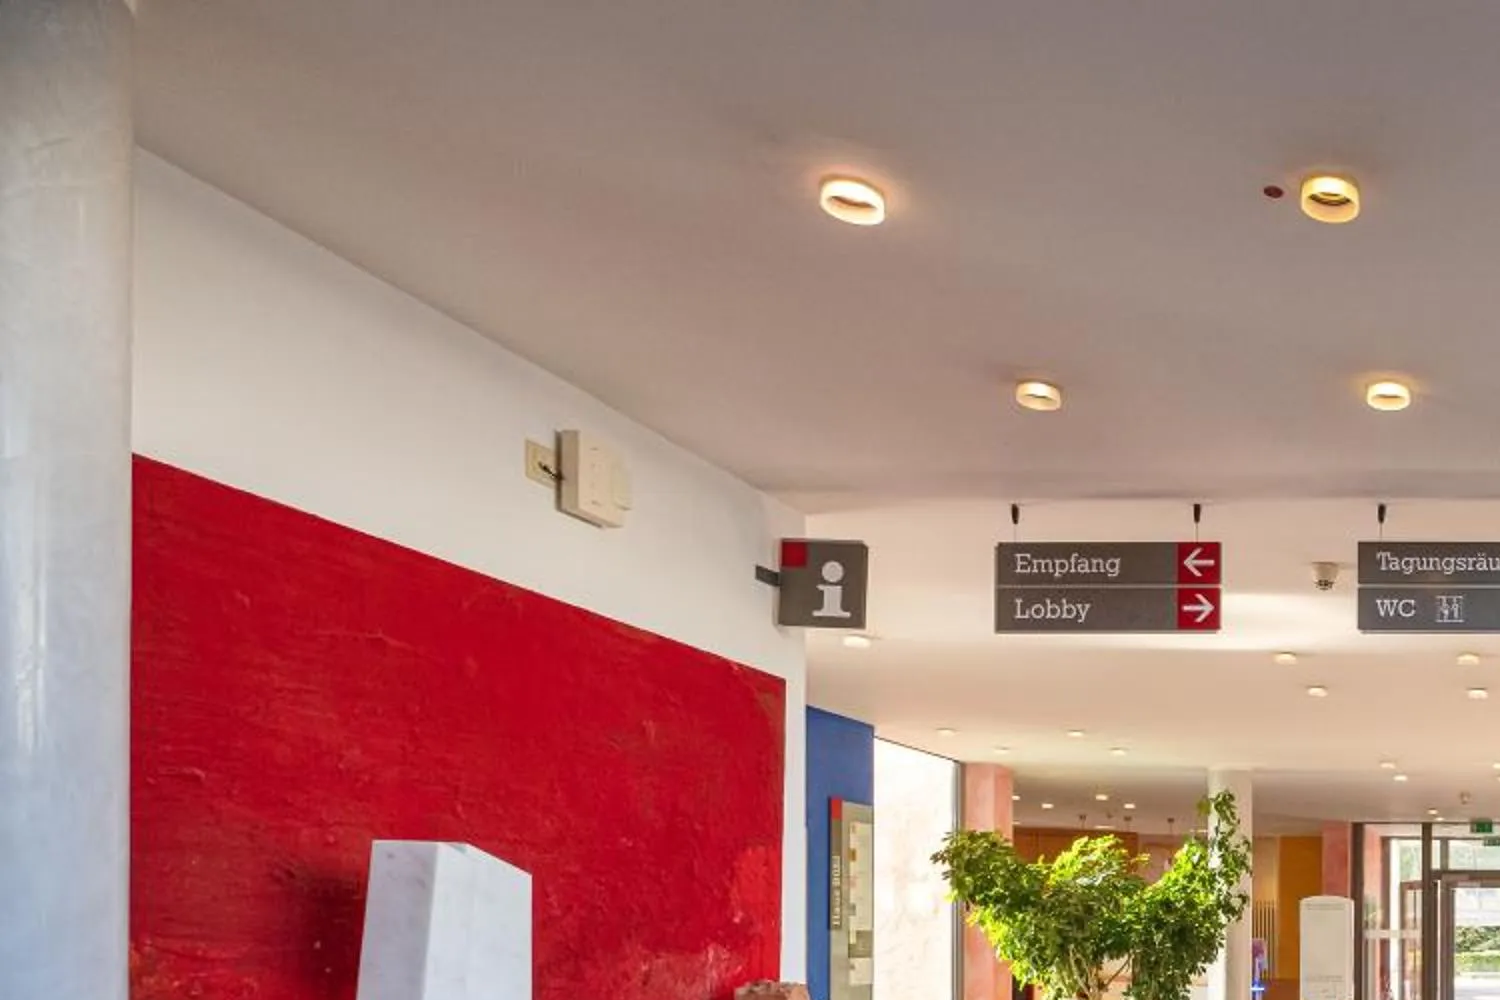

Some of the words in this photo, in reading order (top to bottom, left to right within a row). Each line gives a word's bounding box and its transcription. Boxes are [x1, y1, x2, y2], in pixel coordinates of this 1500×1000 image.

[1014, 553, 1121, 577] Empfang
[1014, 598, 1091, 623] Lobby
[1375, 599, 1416, 617] WC
